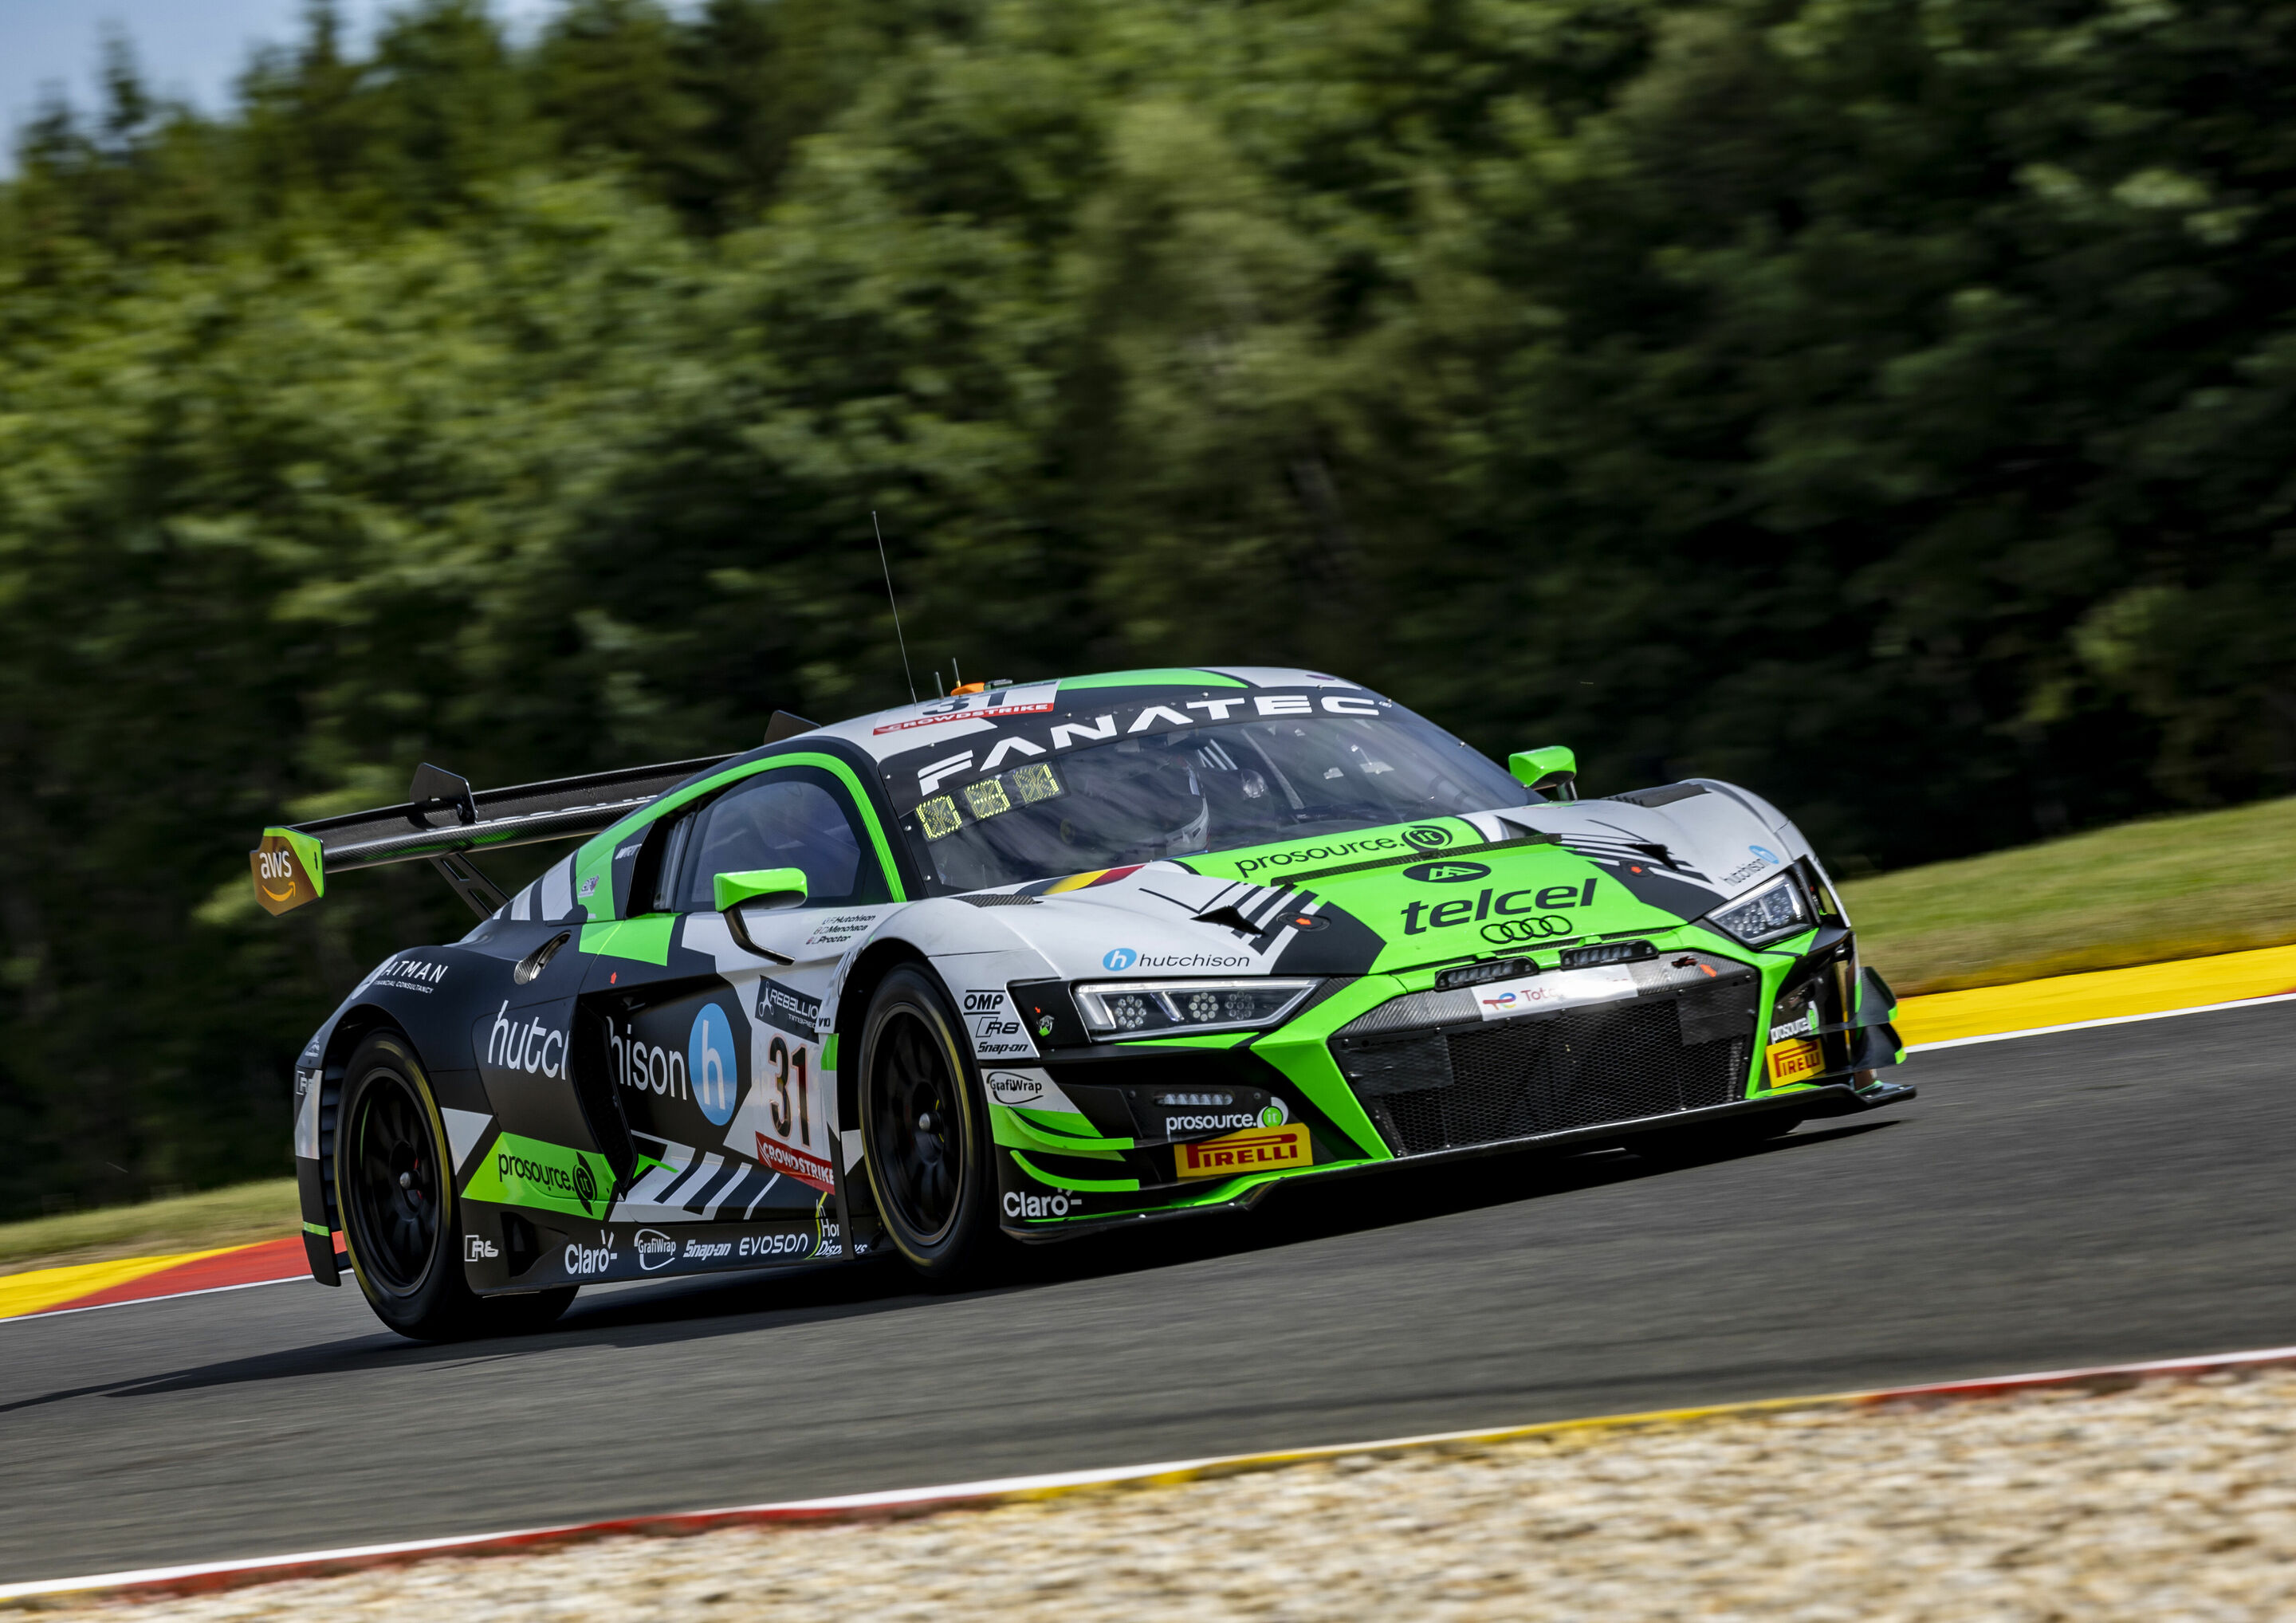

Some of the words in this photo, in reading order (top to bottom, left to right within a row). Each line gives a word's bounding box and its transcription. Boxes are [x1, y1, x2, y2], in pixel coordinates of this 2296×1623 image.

[922, 691, 1008, 715] 31
[888, 704, 1048, 730] CROWDSTRIKE
[917, 695, 1380, 796] FANATEC
[259, 851, 292, 879] aws
[1401, 878, 1598, 936] telcel
[1139, 953, 1250, 967] hutchison
[395, 980, 434, 994] CONSULTANCY
[770, 989, 819, 1020] REBELLIO
[963, 994, 1004, 1010] OMP
[977, 1042, 1028, 1055] Snap-on
[1773, 1041, 1821, 1079] PIRELLI
[702, 1020, 725, 1110] h
[768, 1033, 812, 1150] 31
[989, 1079, 1043, 1094] GrafiWrap
[762, 1142, 835, 1185] CROWDSTRIKE
[1185, 1133, 1299, 1169] PIRELLI
[1003, 1191, 1069, 1217] Claro
[564, 1244, 609, 1275] Claro
[638, 1238, 676, 1256] GrafiWrap
[683, 1240, 731, 1260] Snap-on
[815, 1240, 868, 1257] Dispys
